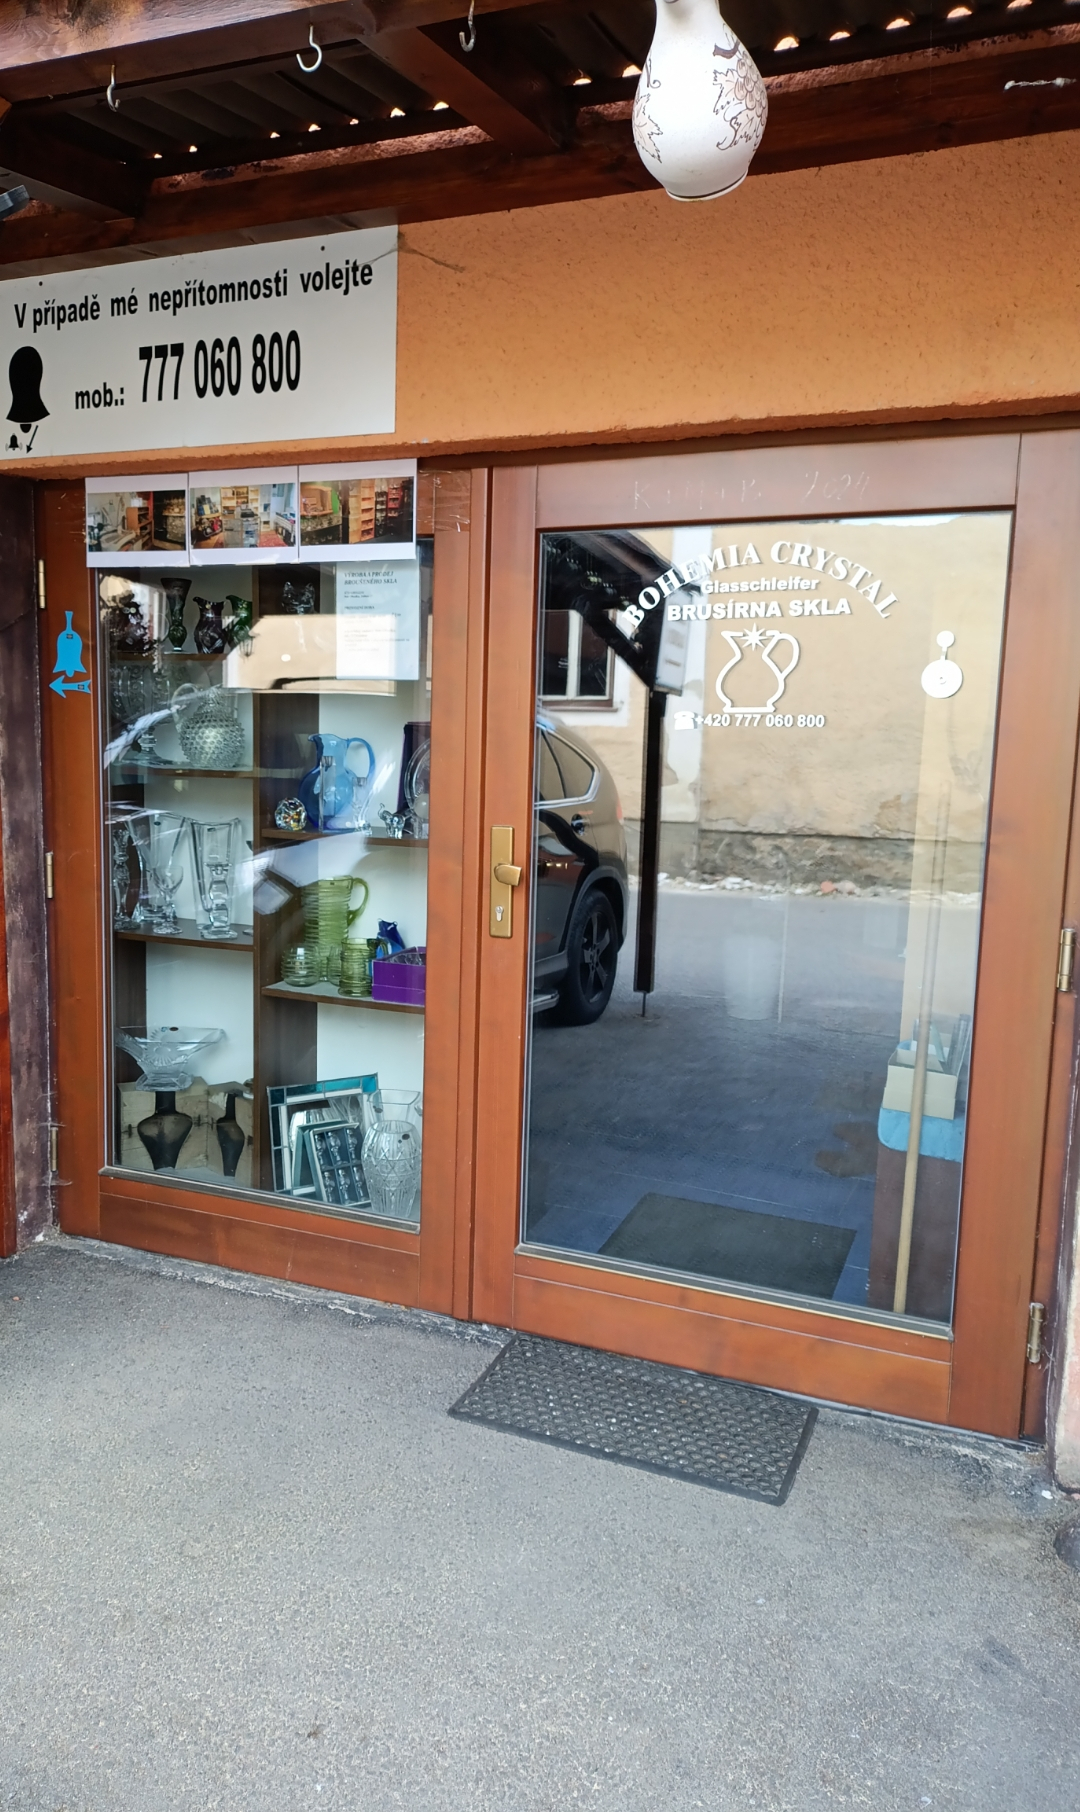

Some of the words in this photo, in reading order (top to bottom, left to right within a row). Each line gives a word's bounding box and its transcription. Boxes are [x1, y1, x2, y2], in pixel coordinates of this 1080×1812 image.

[14, 303, 27, 328] V
[32, 294, 101, 334] případě
[110, 287, 139, 317] mé
[149, 268, 289, 316] nepřítomnosti
[300, 259, 374, 296] volejte
[74, 382, 126, 410] mob.:
[138, 342, 185, 403] 777
[193, 335, 242, 399] 060
[251, 329, 302, 394] 800
[621, 542, 761, 629] BOHEMIA
[770, 540, 899, 619] CRYSTAL
[667, 601, 782, 622] BRUSÍRNA
[788, 597, 851, 617] SKLA
[701, 576, 819, 595] Glasschleifer
[695, 713, 730, 727] +420
[734, 713, 760, 728] 777
[766, 713, 793, 728] 060
[797, 714, 825, 728] 800
